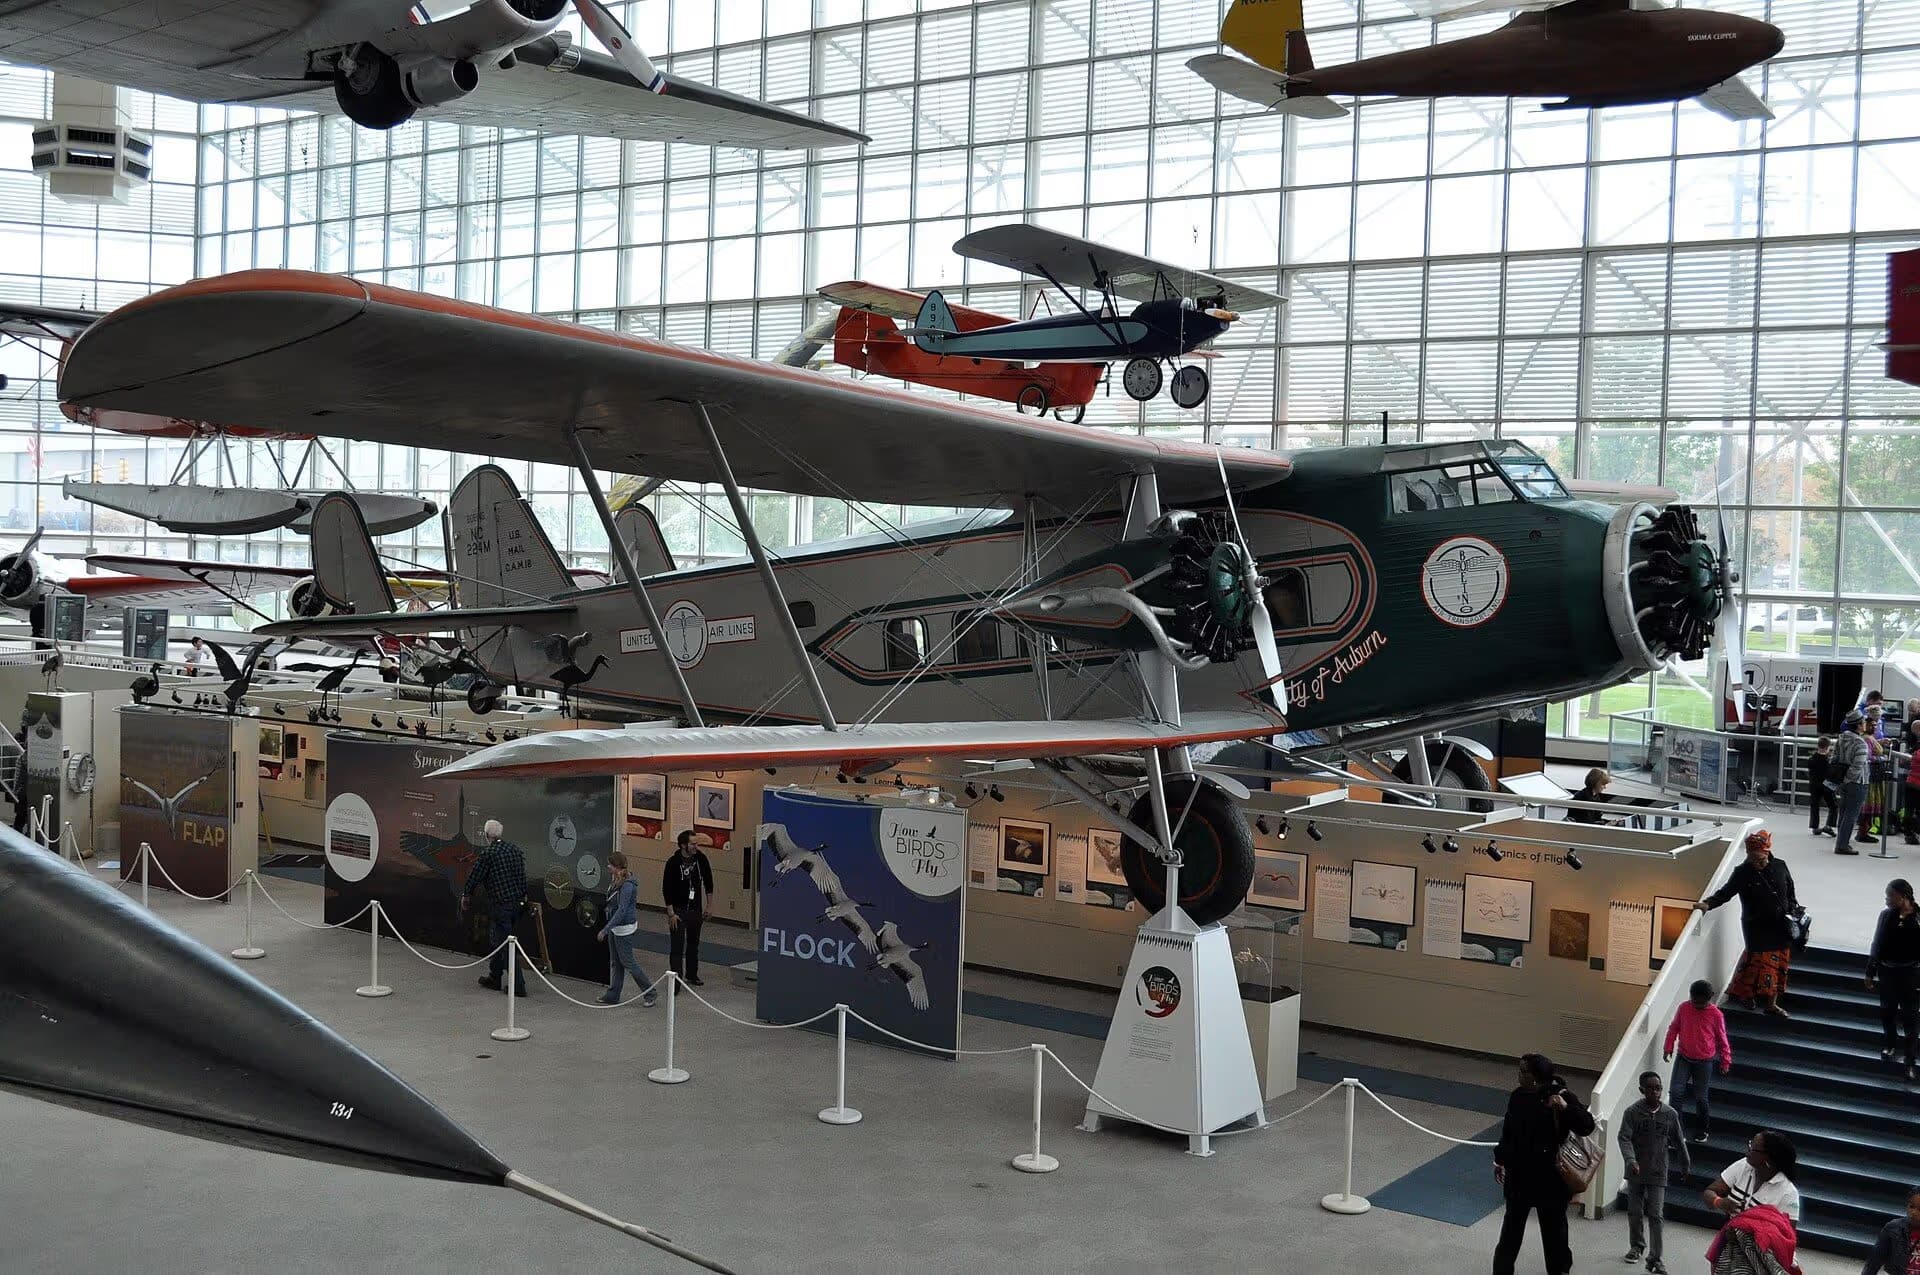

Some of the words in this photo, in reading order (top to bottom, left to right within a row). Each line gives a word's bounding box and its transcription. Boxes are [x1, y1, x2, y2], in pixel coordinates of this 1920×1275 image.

[471, 526, 484, 541] NC
[466, 540, 491, 556] 224M
[508, 545, 525, 556] MAIL
[1447, 612, 1488, 624] TRANSPORT
[626, 633, 655, 647] UNITED
[709, 626, 724, 638] AIR
[728, 622, 754, 636] LINES
[1311, 667, 1331, 700] of
[1332, 630, 1387, 684] Auburn
[1744, 670, 1754, 685] 1
[1775, 675, 1814, 683] MUSEUM
[183, 821, 225, 847] FLAP
[888, 821, 919, 838] How
[896, 837, 945, 859] BIRDS
[1530, 852, 1541, 862] of
[911, 859, 939, 878] Fly
[763, 927, 856, 968] FLOCK
[1150, 981, 1179, 995] BIRDS
[330, 1101, 354, 1120] 134
